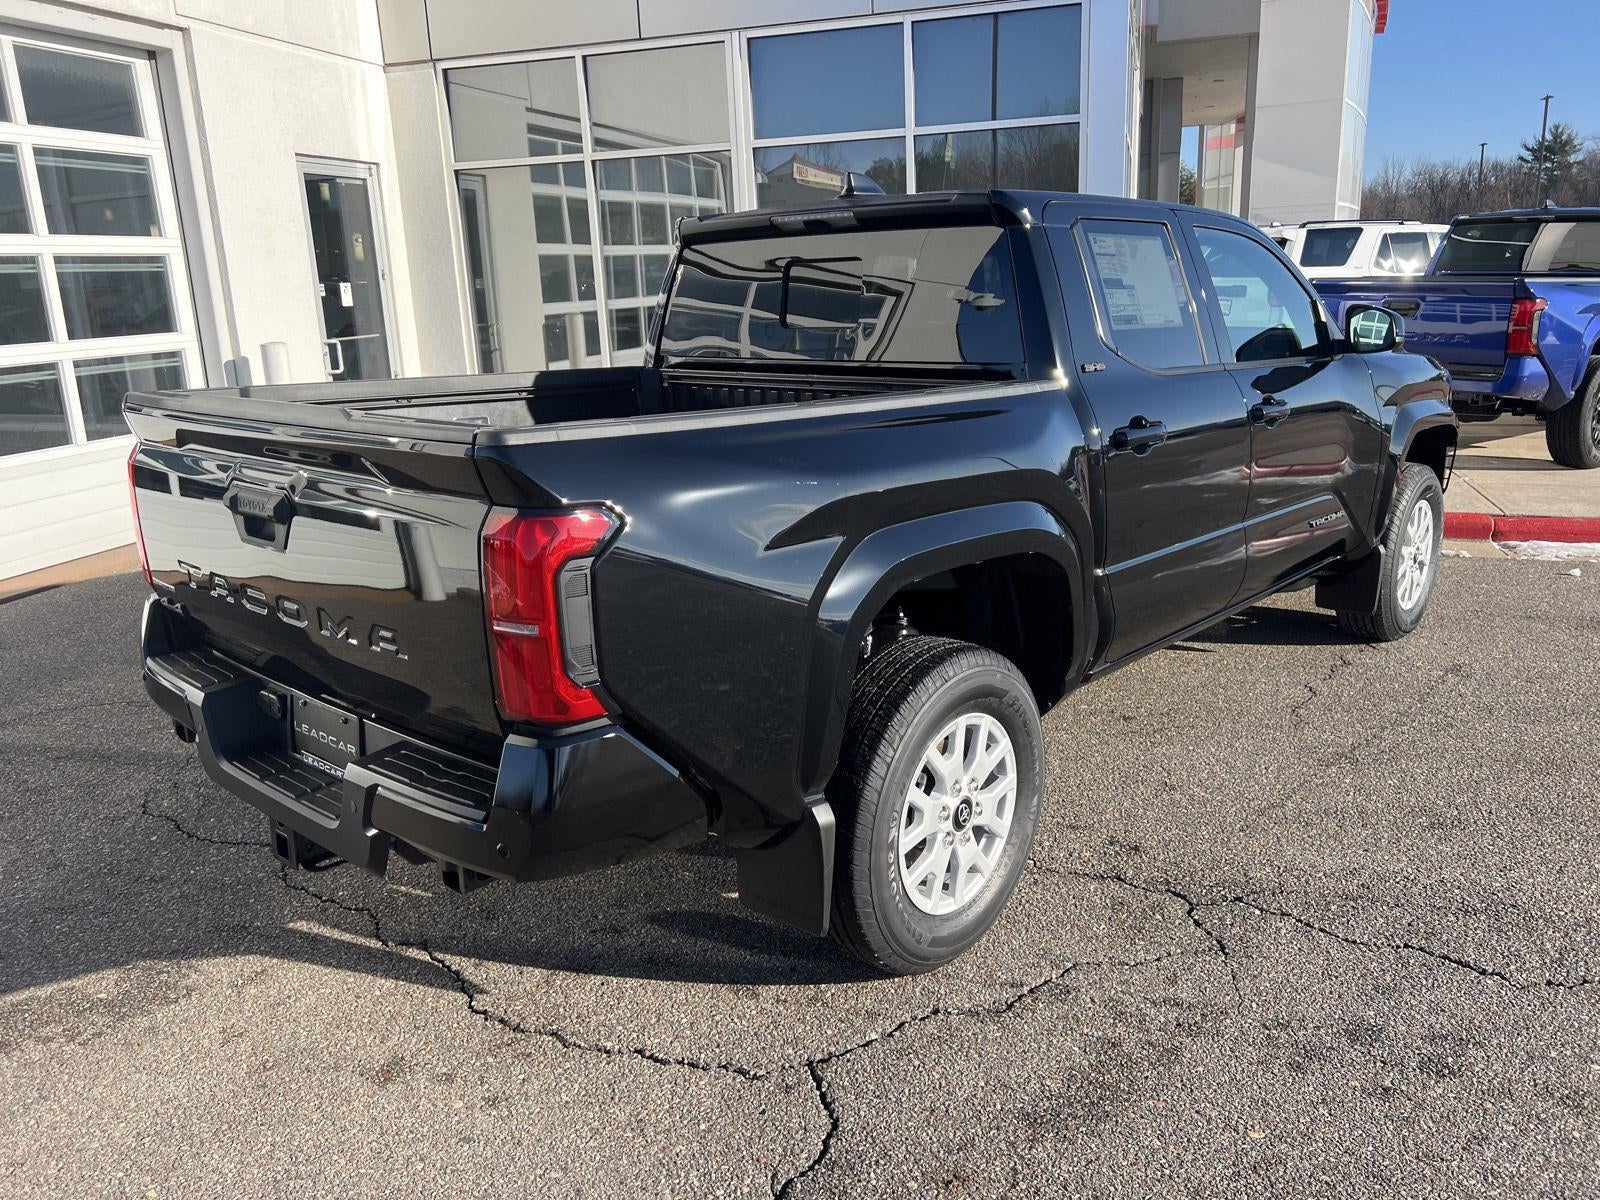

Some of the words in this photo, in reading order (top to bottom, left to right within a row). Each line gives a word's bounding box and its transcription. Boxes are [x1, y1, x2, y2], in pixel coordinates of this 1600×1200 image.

[1404, 331, 1470, 344] OMA
[239, 498, 267, 514] TOYOTA
[1307, 510, 1344, 528] TACOMA
[178, 559, 408, 661] TACOMA
[294, 720, 356, 757] LEADCAR
[303, 754, 343, 777] LEADCAR
